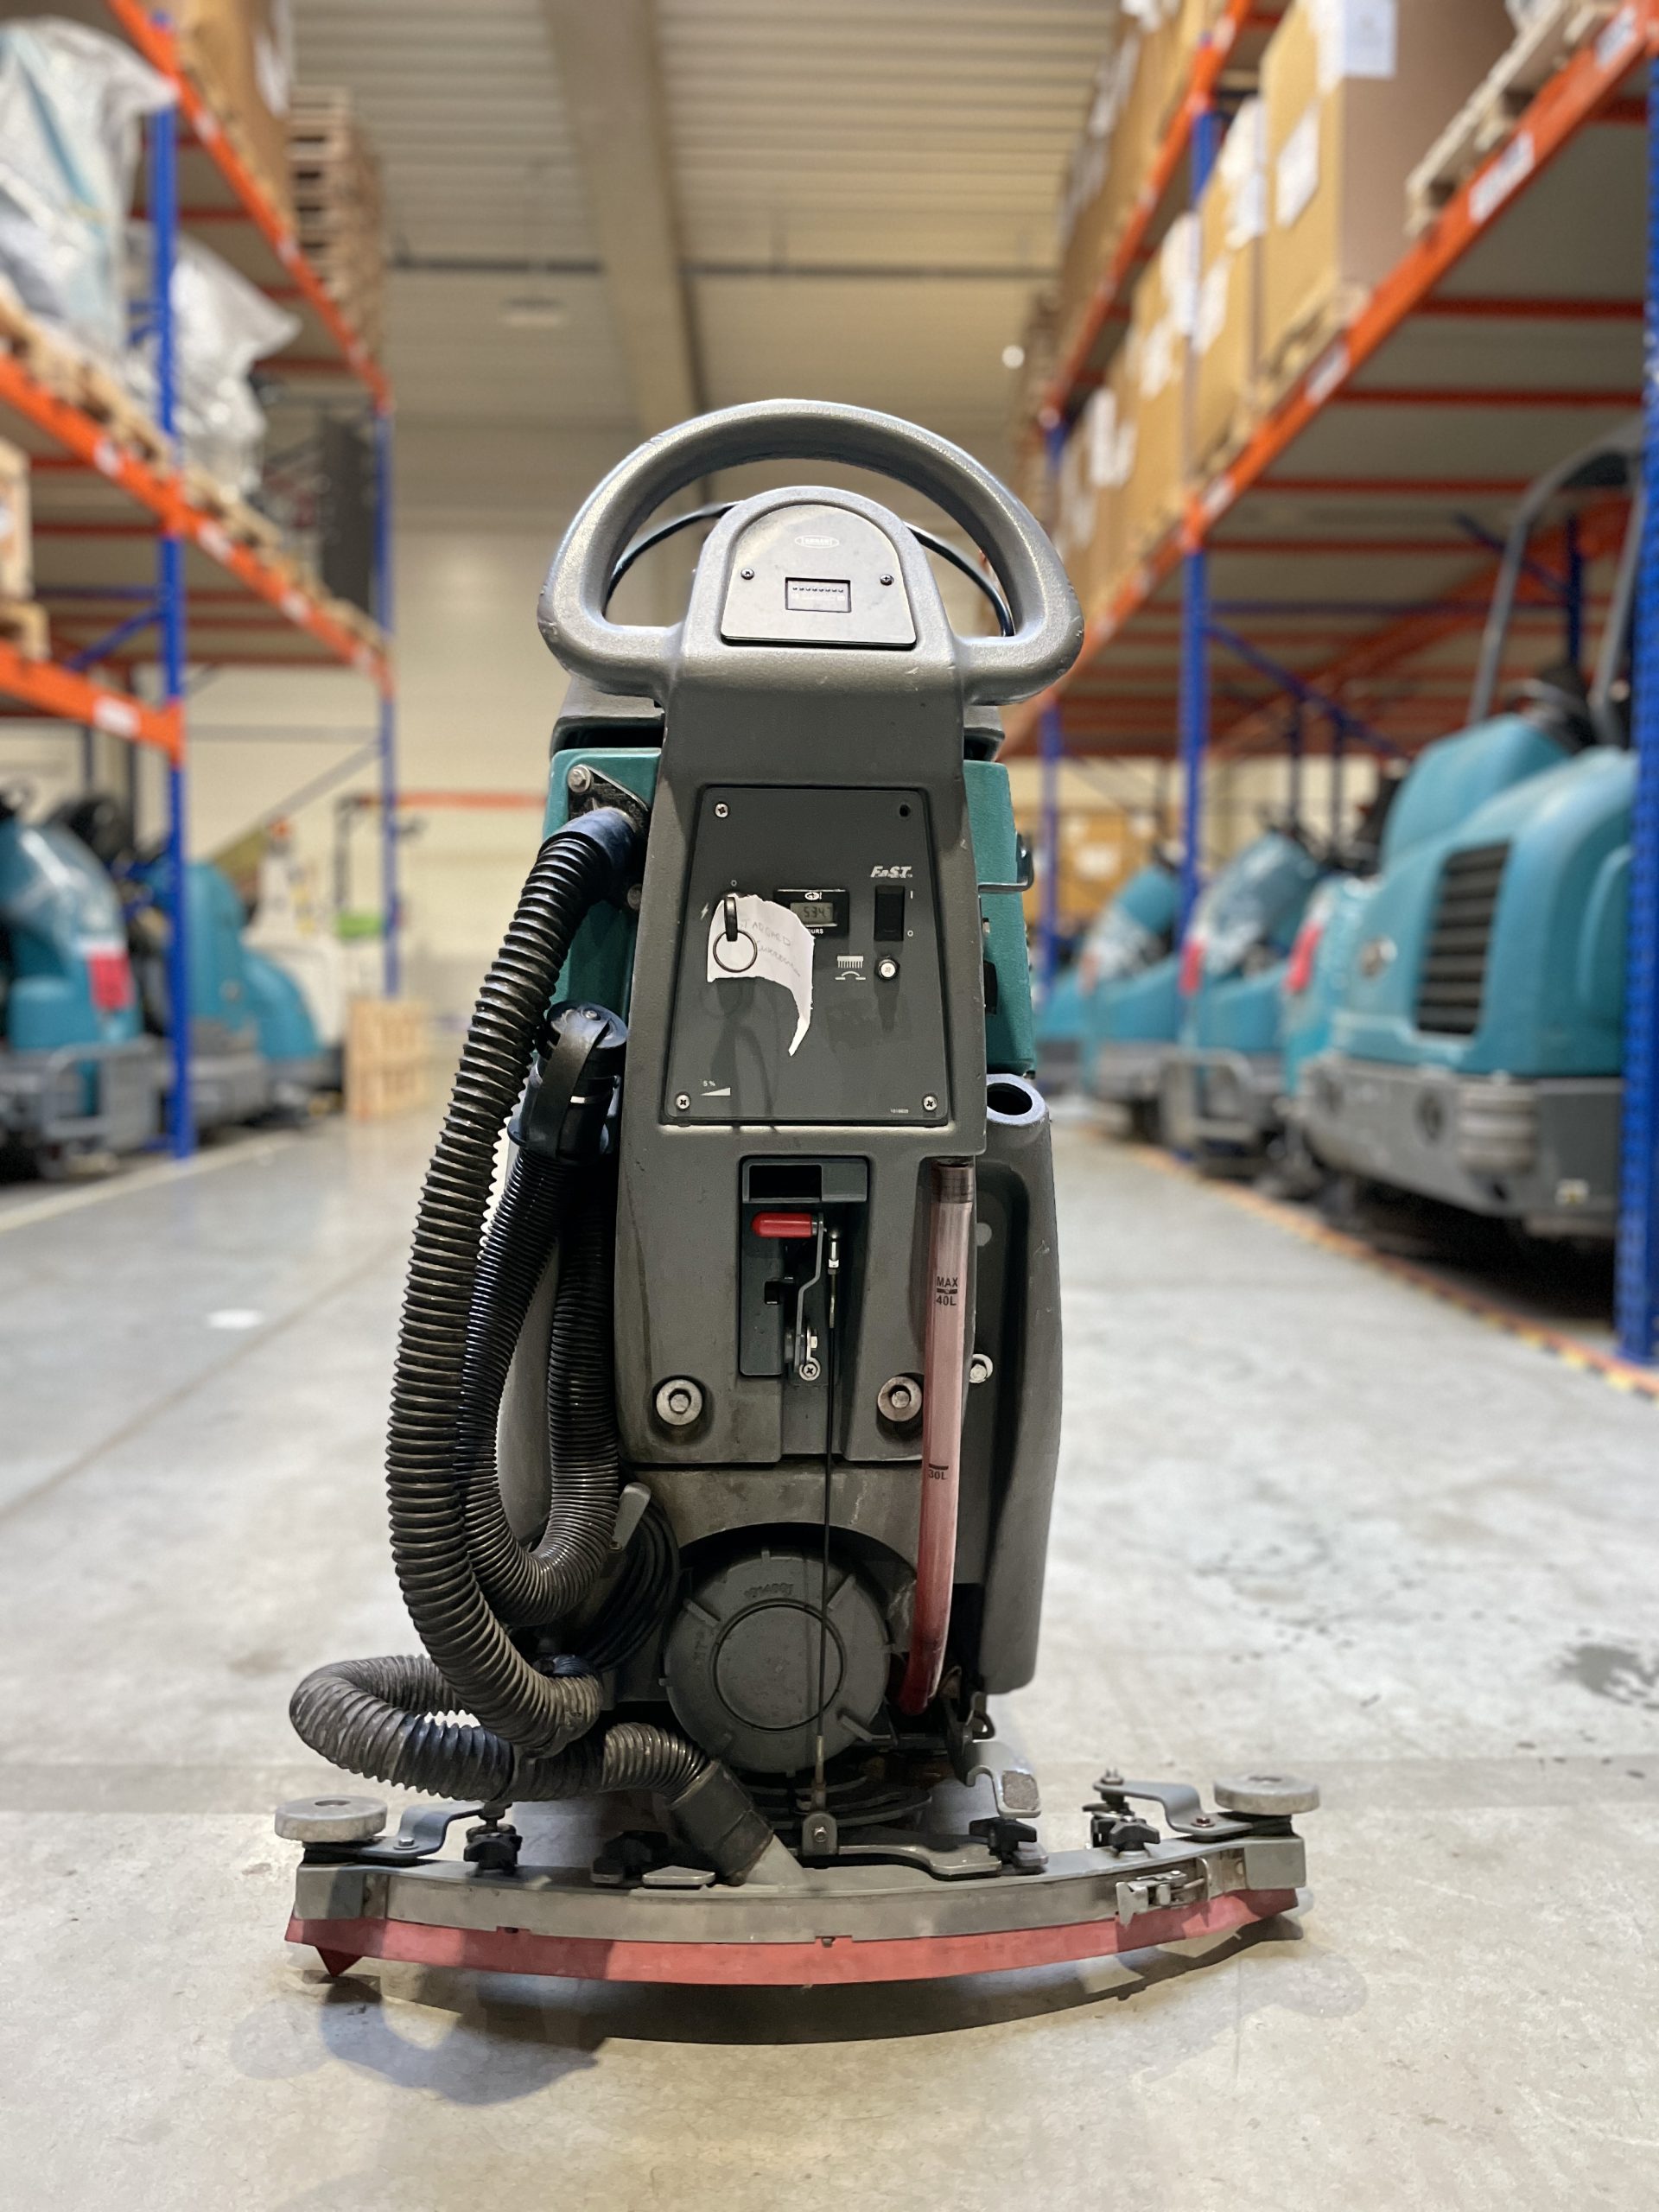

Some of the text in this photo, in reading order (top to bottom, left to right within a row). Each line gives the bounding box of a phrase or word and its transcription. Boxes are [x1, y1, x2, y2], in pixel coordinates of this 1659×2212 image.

[936, 1275, 959, 1288] MAX
[936, 1294, 957, 1306] 40L
[928, 1469, 949, 1480] 30L
